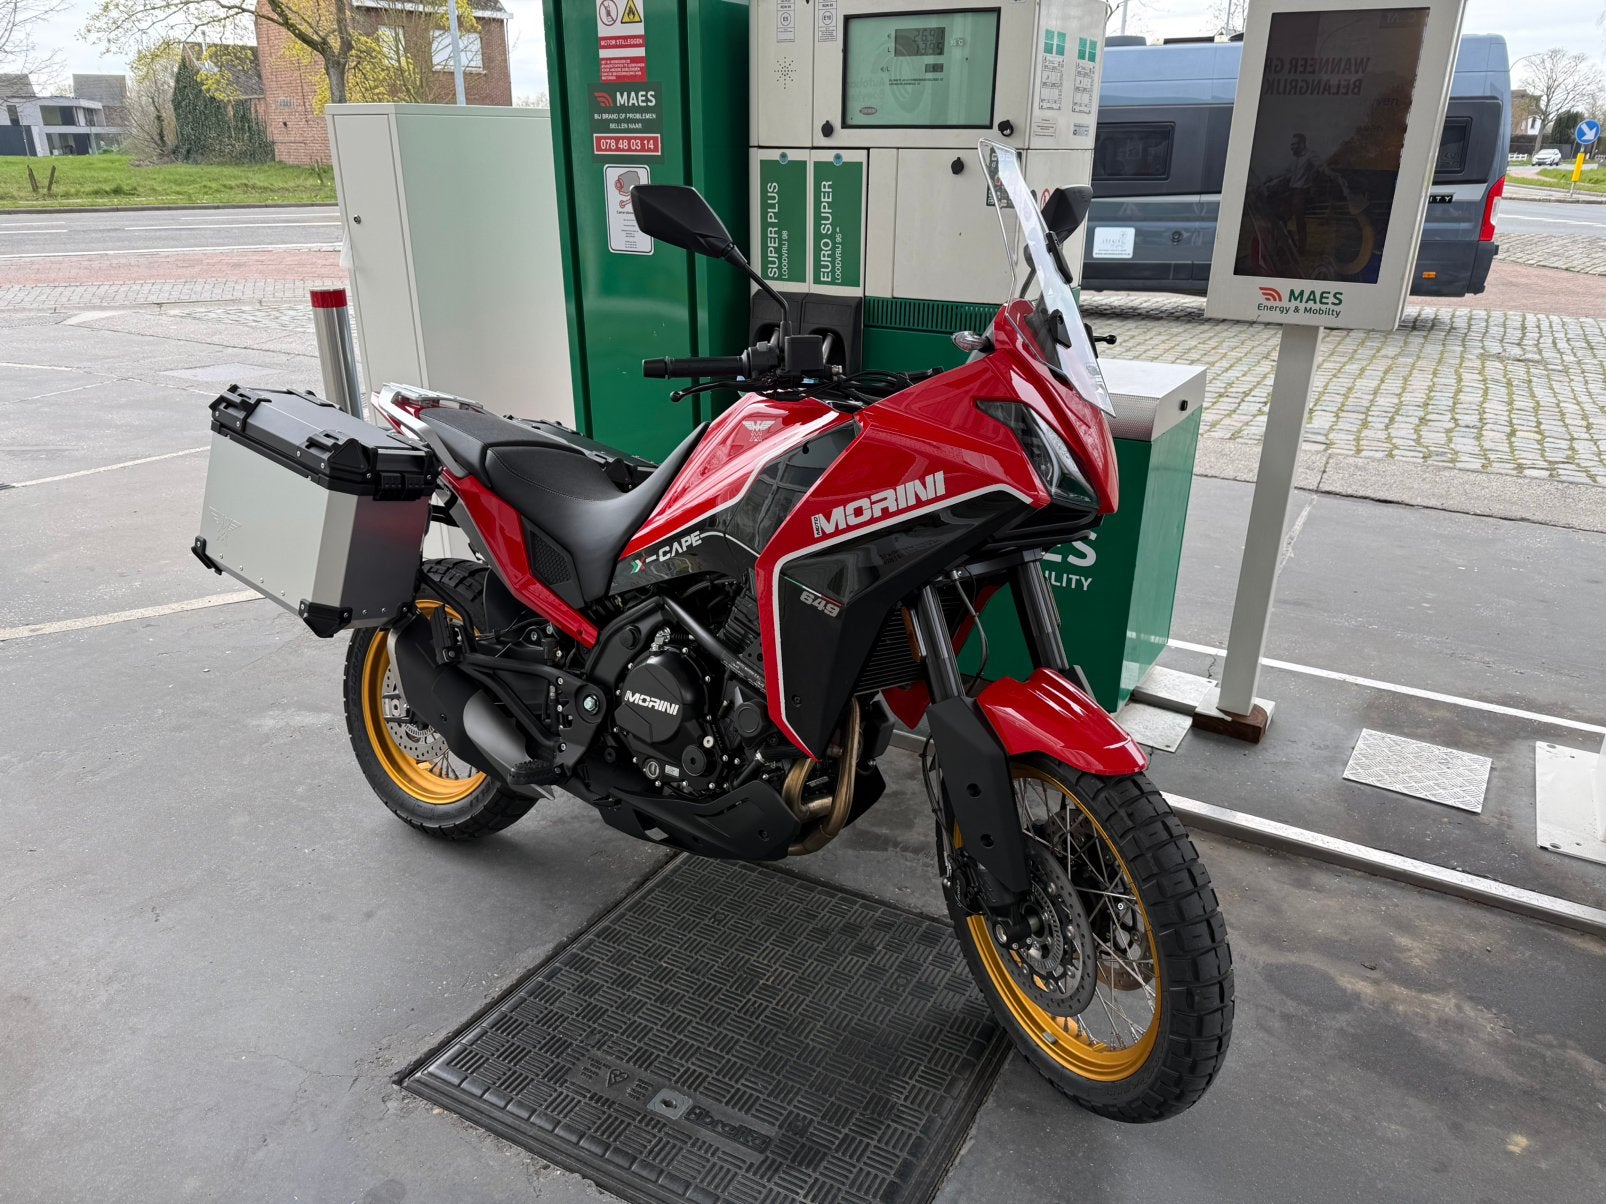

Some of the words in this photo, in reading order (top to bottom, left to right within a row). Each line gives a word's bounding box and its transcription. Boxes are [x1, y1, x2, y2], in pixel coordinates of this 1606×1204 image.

[616, 91, 656, 107] MAES
[600, 139, 616, 150] 078
[618, 139, 628, 150] 48
[631, 139, 641, 150] 03
[644, 139, 654, 150] 14
[767, 182, 779, 223] PLUS
[820, 180, 832, 235] SUPER
[1429, 195, 1453, 204] ITY
[781, 229, 788, 239] 98
[835, 233, 842, 243] 95
[767, 227, 779, 278] SUPER
[780, 240, 788, 279] LOODVRIJ
[820, 238, 832, 282] EURO
[1288, 288, 1343, 306] MAES
[1257, 303, 1290, 314] Energy
[1293, 306, 1300, 314] &
[1303, 306, 1341, 318] Mobilty
[818, 470, 946, 534] MORINI
[630, 530, 702, 574] X-CAPE
[799, 591, 840, 618] 649
[628, 690, 679, 716] MORINI
